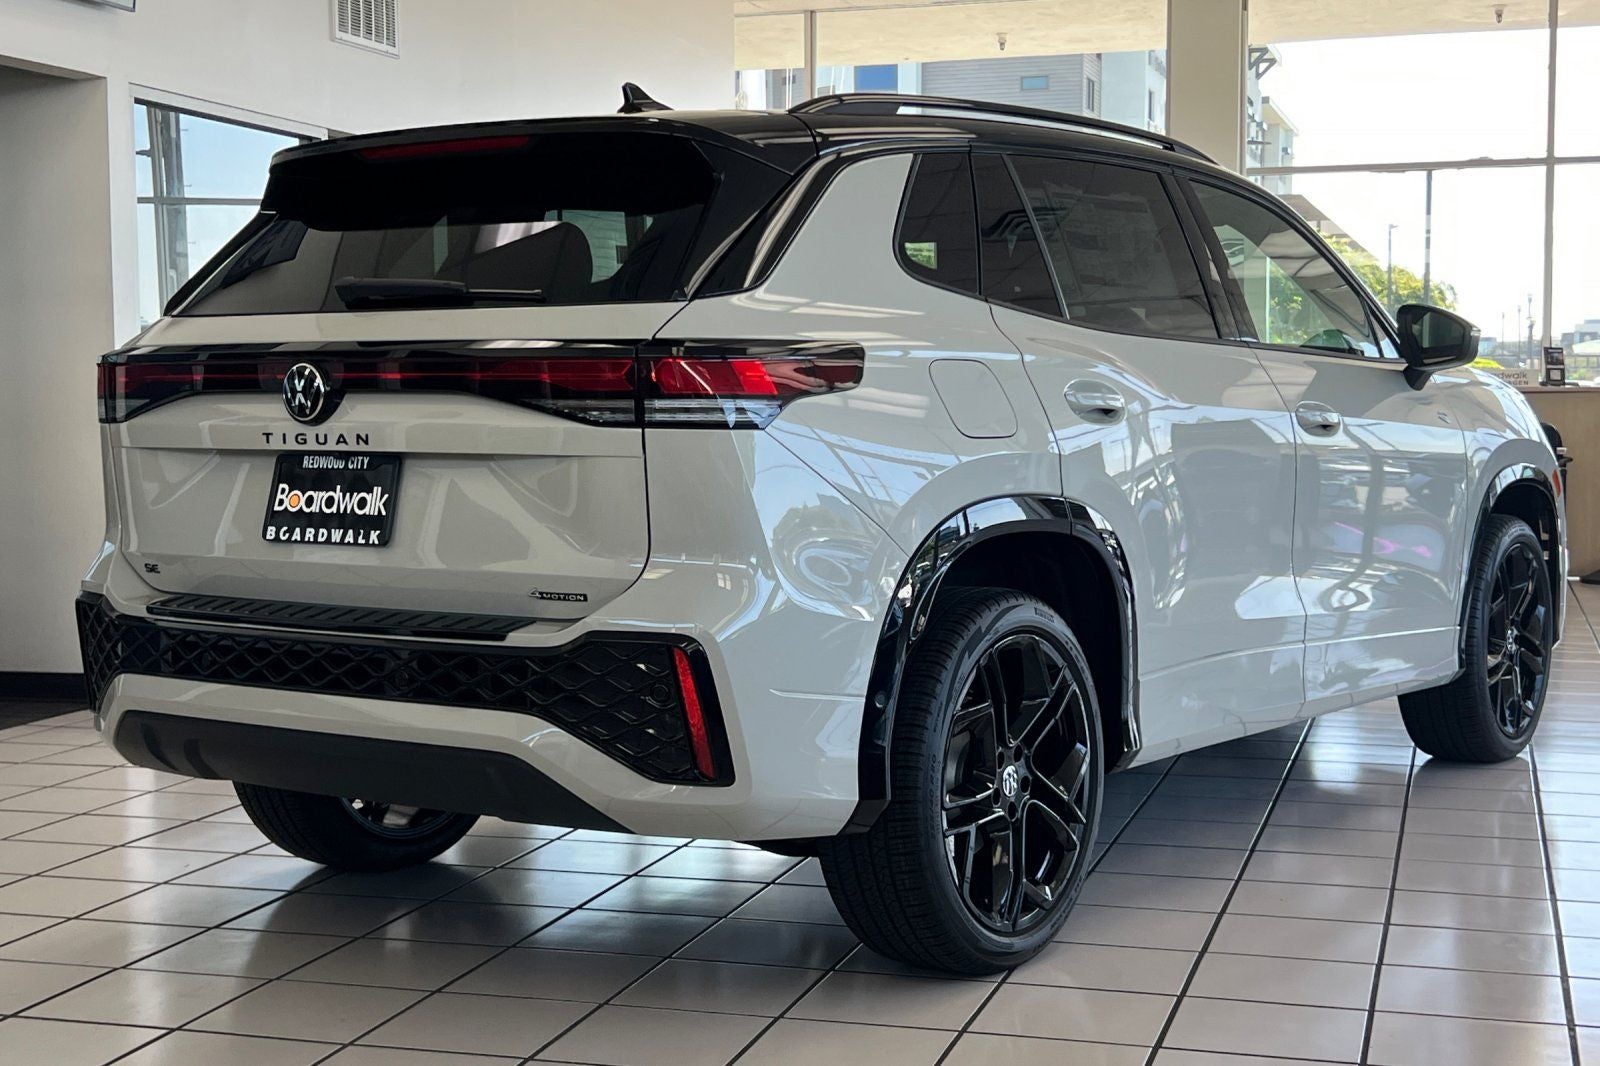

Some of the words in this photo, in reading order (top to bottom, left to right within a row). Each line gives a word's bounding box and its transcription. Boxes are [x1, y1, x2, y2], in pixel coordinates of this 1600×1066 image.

[1493, 371, 1528, 379] dwalk
[262, 432, 369, 446] TIGUAN
[303, 455, 345, 469] REDWOOD
[348, 456, 369, 470] CITY
[273, 483, 389, 516] Boardwalk
[266, 526, 380, 544] BOARDWALK
[144, 563, 160, 574] SE
[528, 587, 585, 601] 4MOTION
